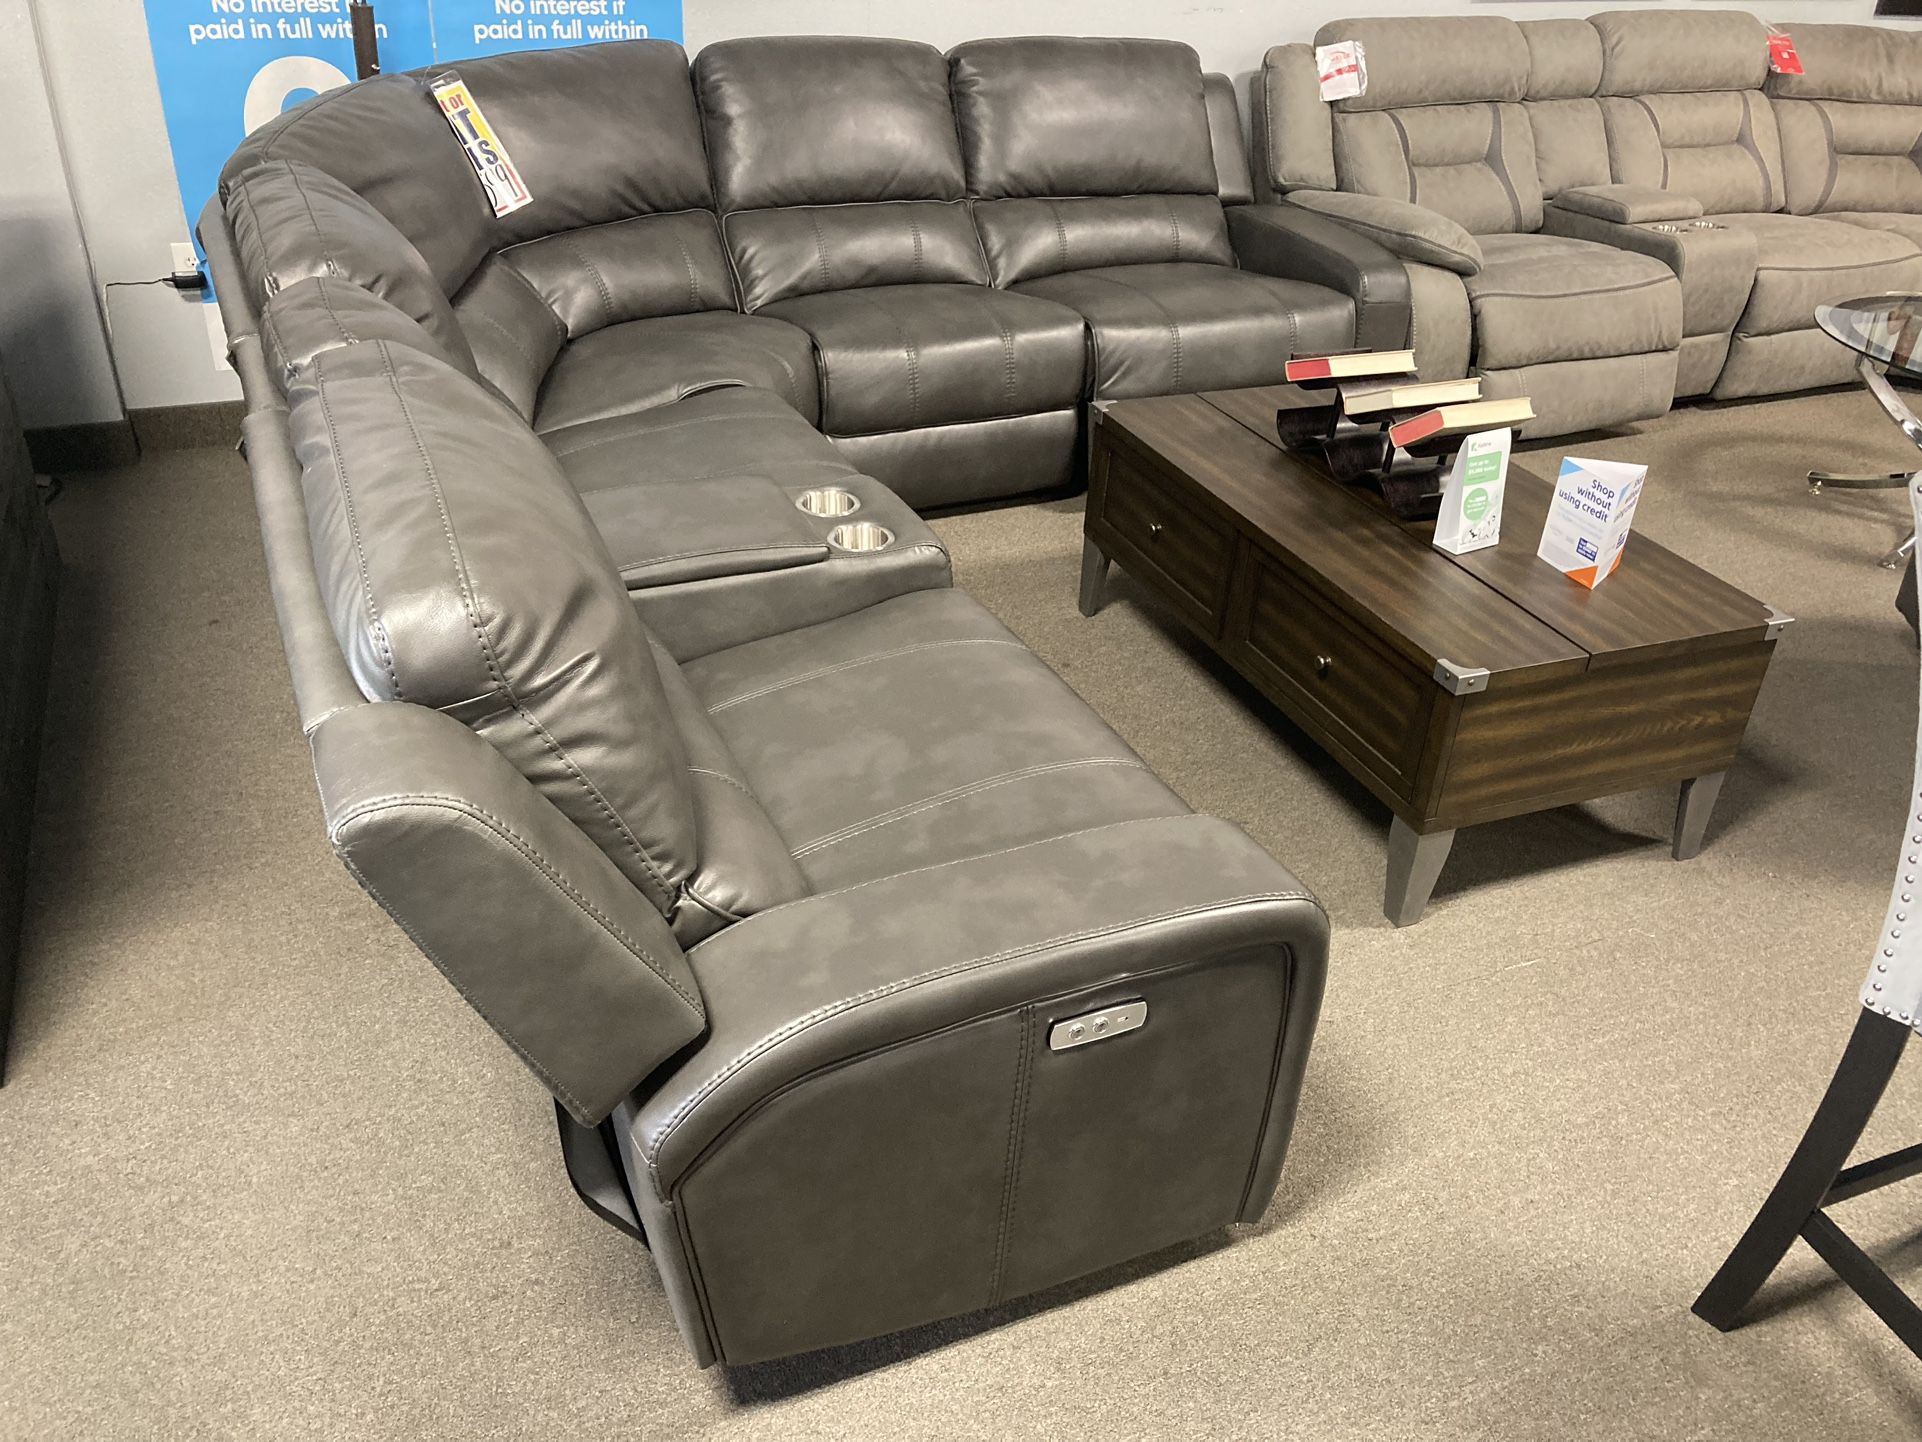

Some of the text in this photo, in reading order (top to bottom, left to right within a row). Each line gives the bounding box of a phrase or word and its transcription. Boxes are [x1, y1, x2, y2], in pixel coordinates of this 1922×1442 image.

[211, 0, 244, 13] No
[251, 0, 340, 13] interest
[494, 0, 626, 15] No interest if
[188, 17, 388, 45] paid in full witn
[474, 19, 648, 44] paid in full within
[1577, 486, 1612, 511] without
[1592, 479, 1615, 499] Shop
[1558, 489, 1581, 509] using
[1582, 503, 1609, 523] credit
